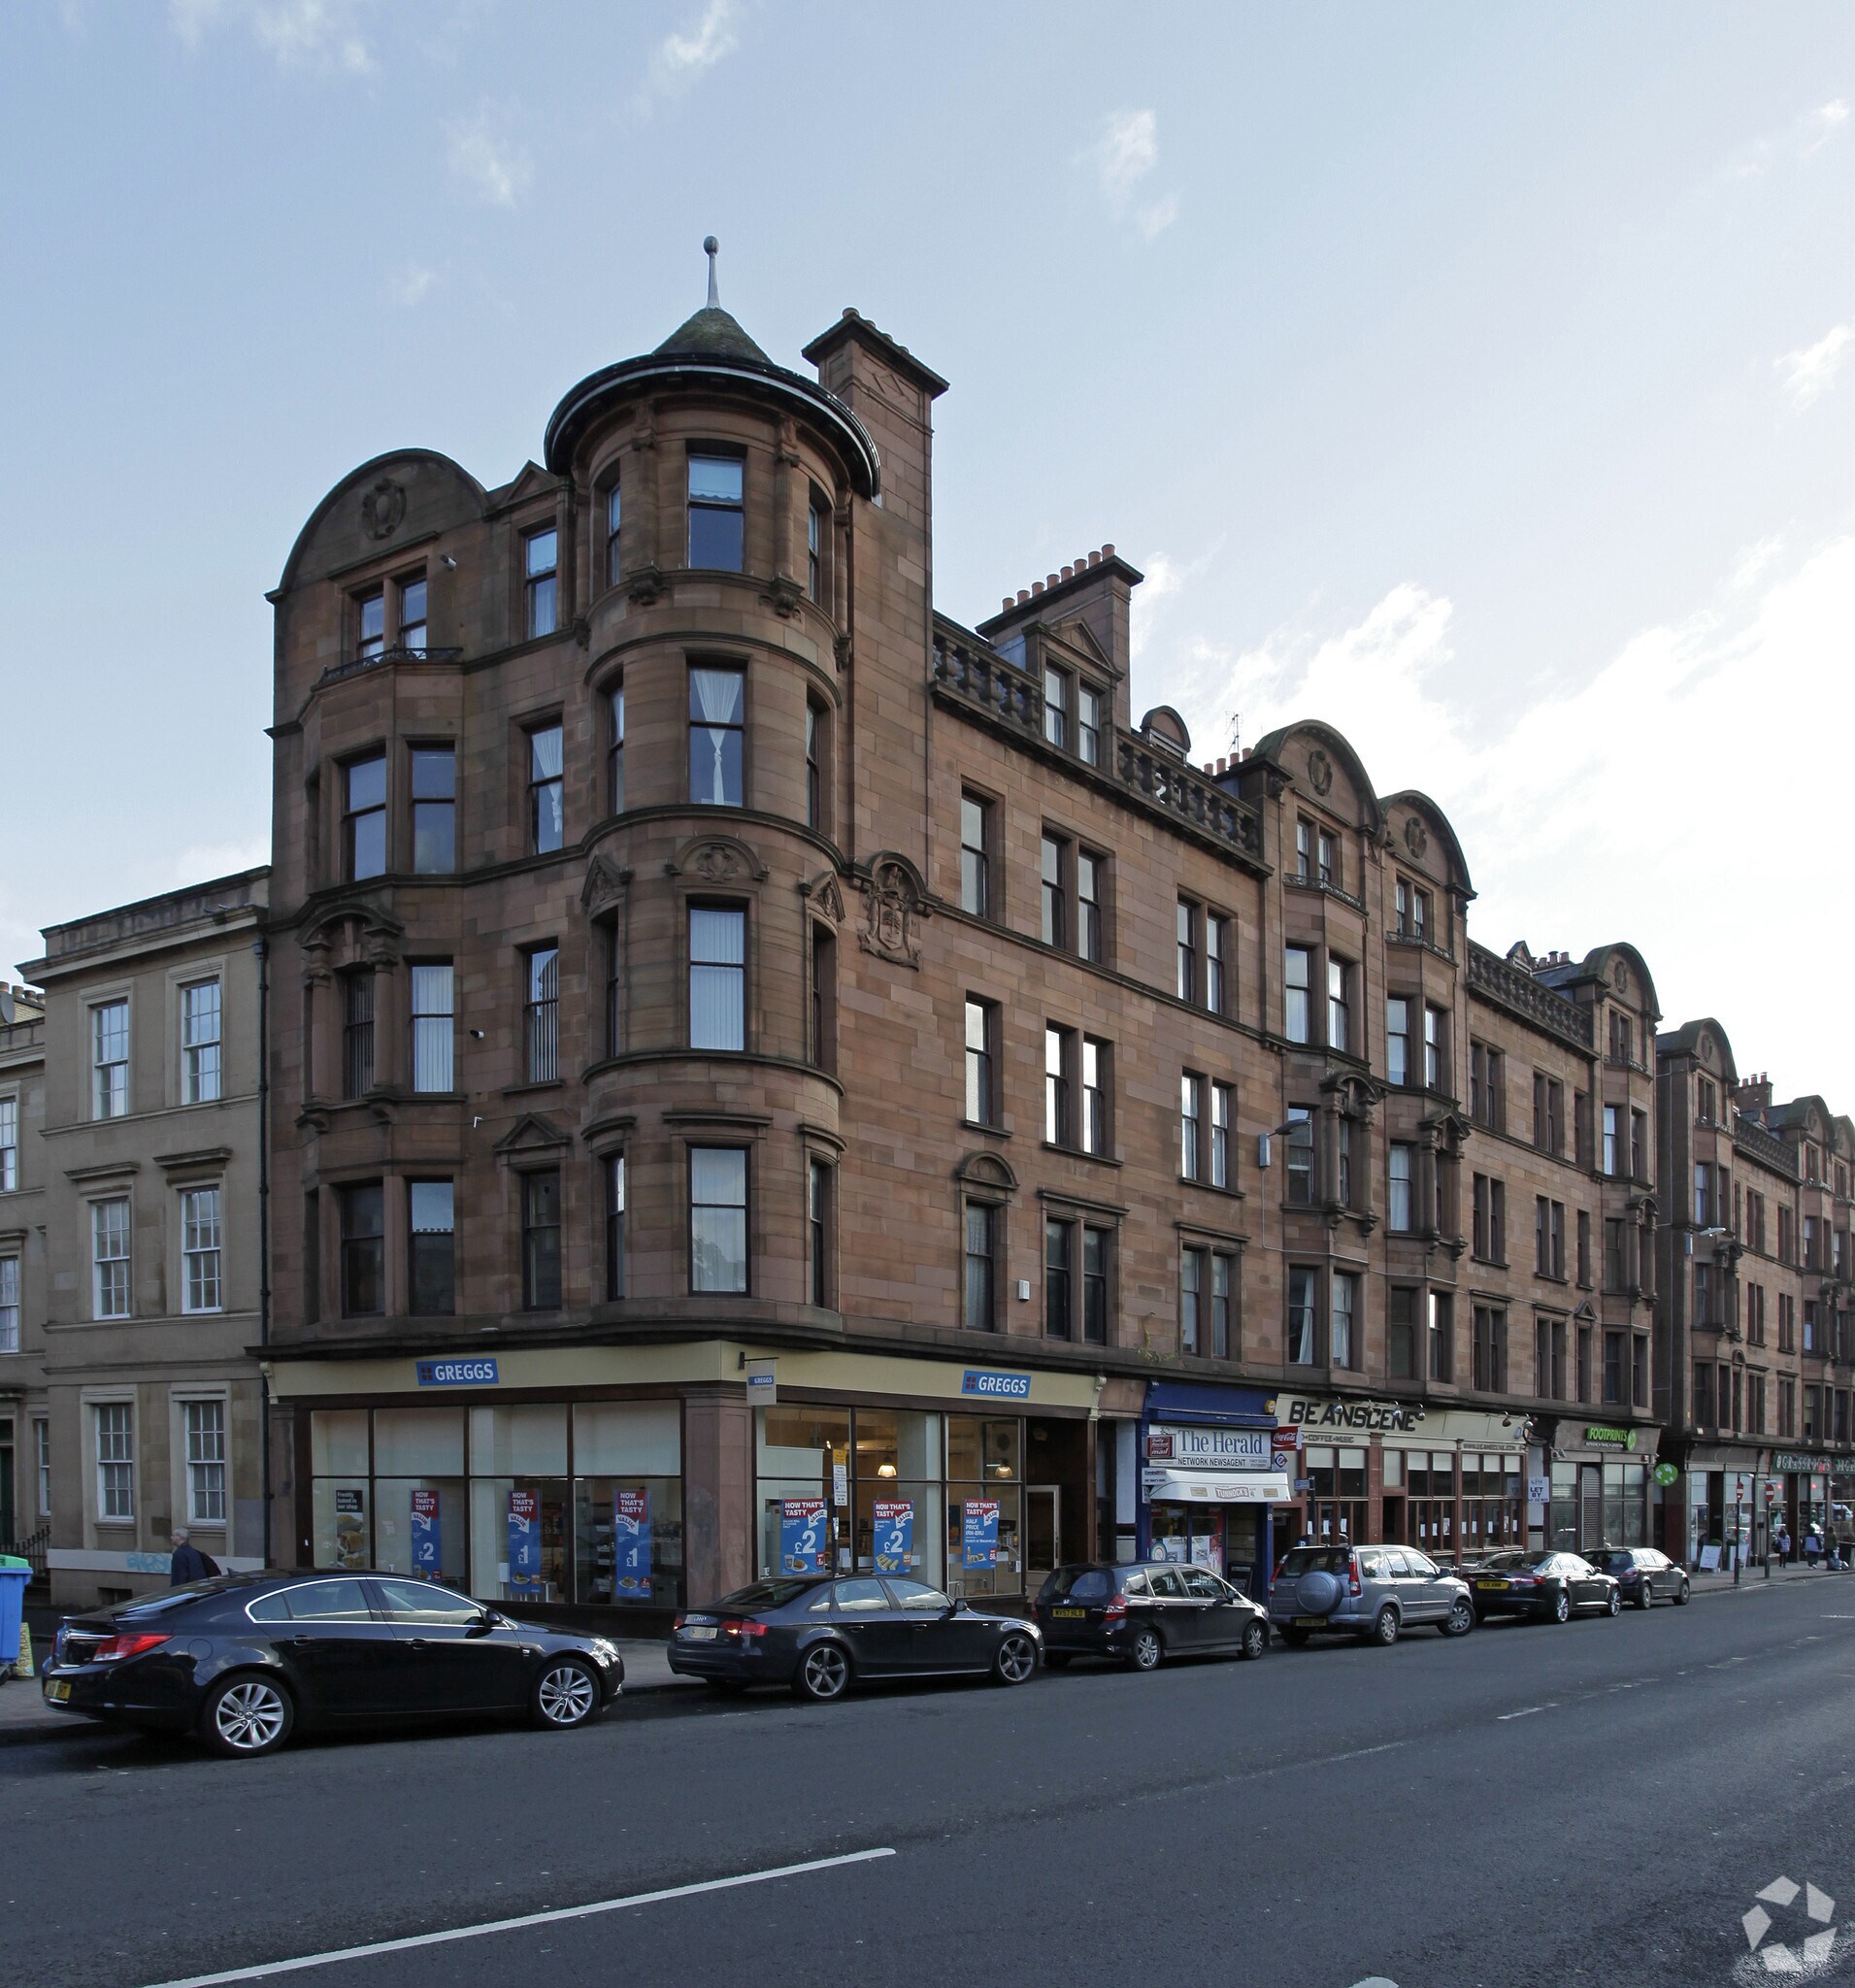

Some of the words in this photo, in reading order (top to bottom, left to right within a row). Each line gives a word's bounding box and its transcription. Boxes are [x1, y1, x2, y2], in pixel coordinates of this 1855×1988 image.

[435, 1363, 494, 1381] GREGGS
[978, 1376, 1027, 1394] GREGGS
[1289, 1401, 1417, 1432] BEANSCENE
[1177, 1430, 1209, 1452] The
[1212, 1432, 1263, 1454] Herald
[1589, 1427, 1628, 1441] FOOTPRINTS
[1209, 1458, 1246, 1467] NEWSAGENT
[510, 1514, 527, 1528] VALUE
[616, 1514, 636, 1529] VALUE
[418, 1542, 434, 1561] £2
[794, 1530, 816, 1554] £2
[883, 1530, 904, 1554] £2
[518, 1545, 529, 1564] £1
[626, 1547, 638, 1567] £1
